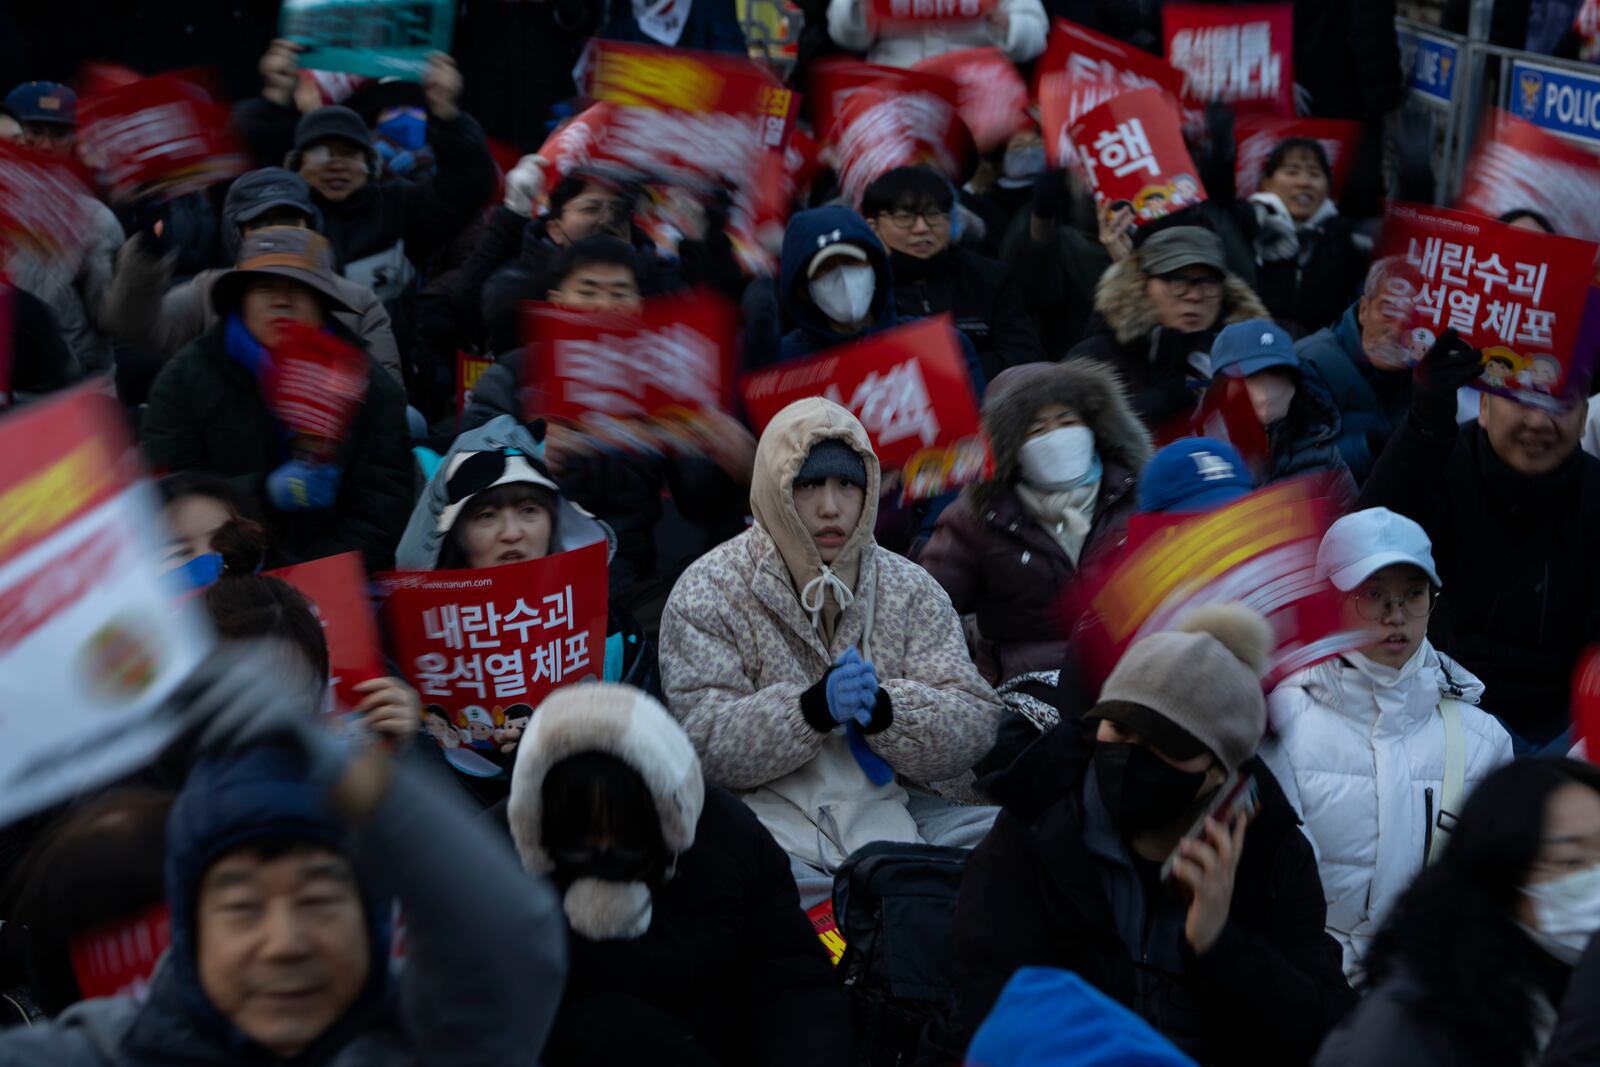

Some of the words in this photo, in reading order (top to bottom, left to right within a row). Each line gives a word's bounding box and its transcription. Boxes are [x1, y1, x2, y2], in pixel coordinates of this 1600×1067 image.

[1406, 236, 1549, 309] 내란수괴
[1481, 298, 1557, 350] 체포
[421, 577, 493, 590] www.nanum.com
[422, 584, 575, 650] 내란수괴
[414, 648, 528, 700] 윤석열
[530, 630, 591, 684] 체포
